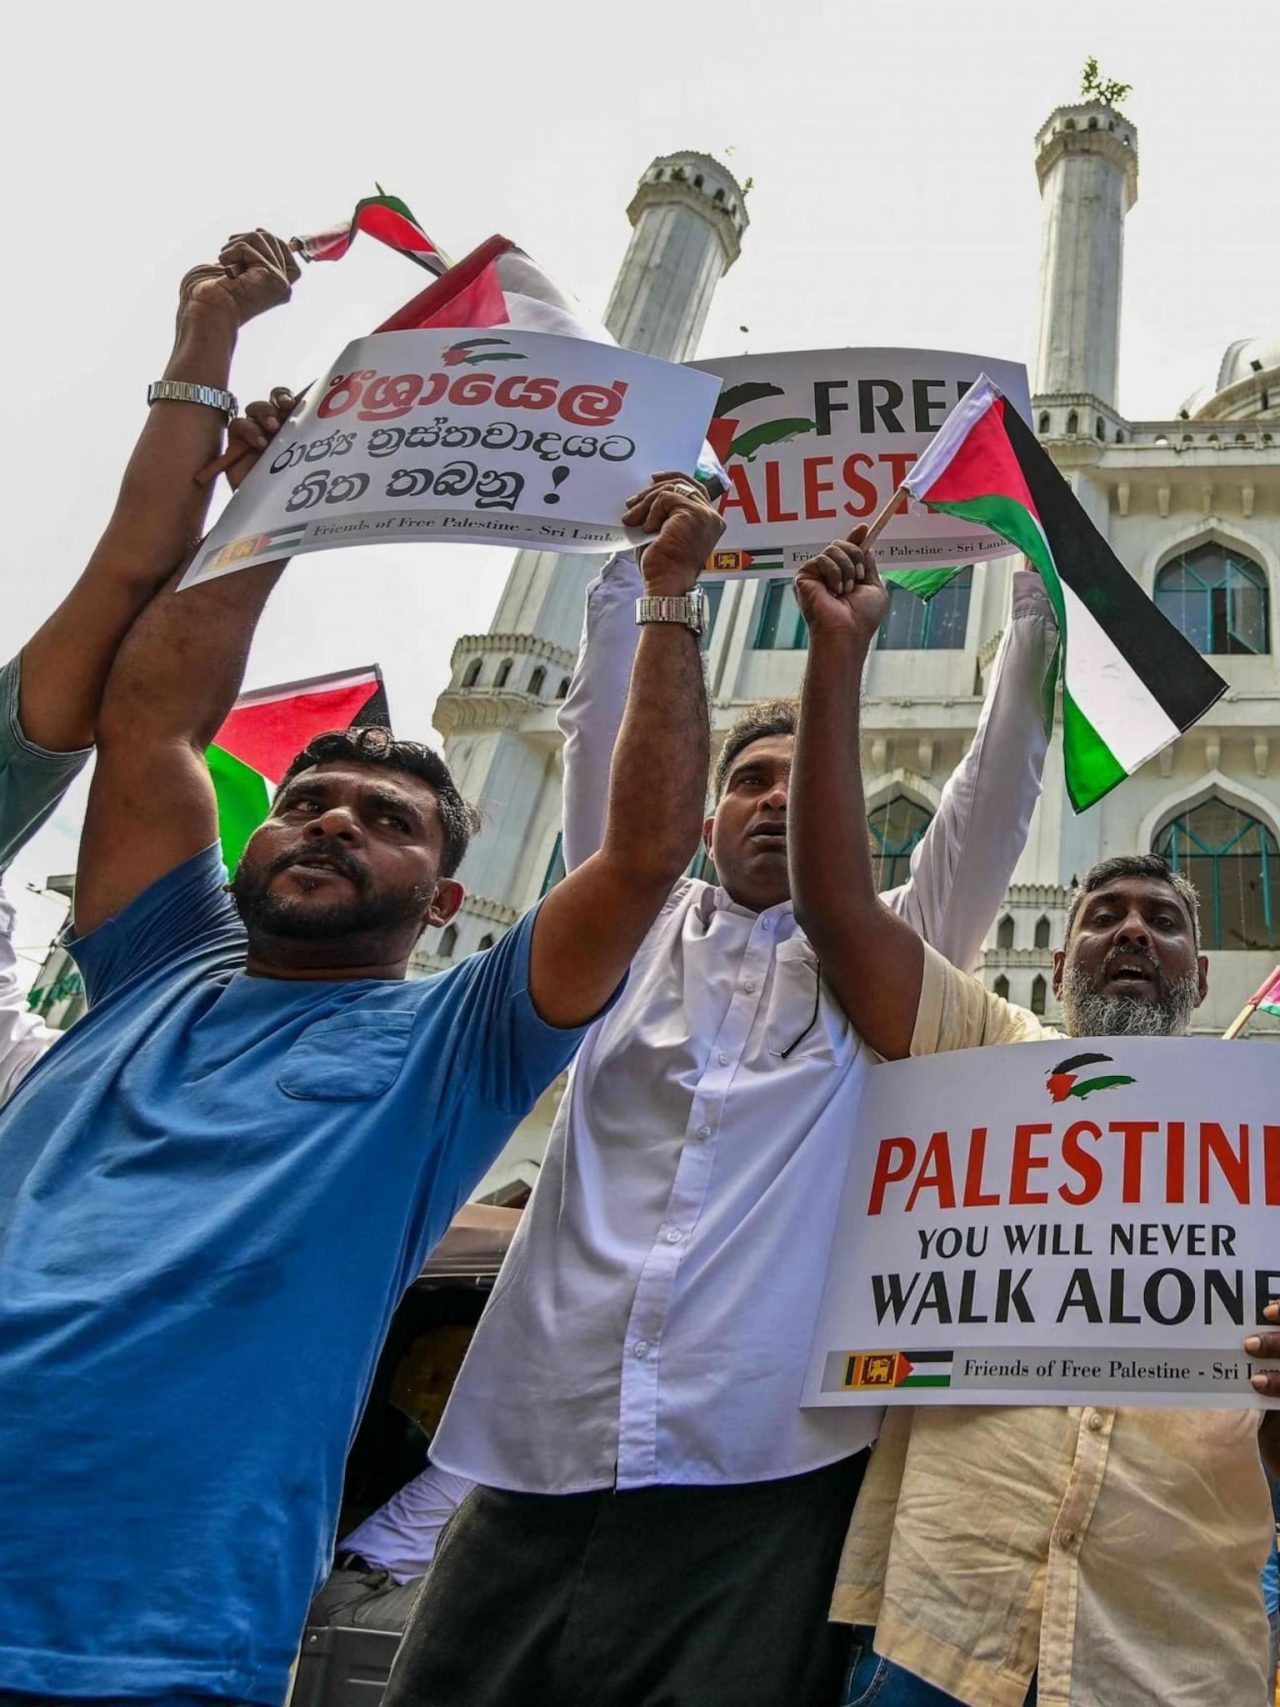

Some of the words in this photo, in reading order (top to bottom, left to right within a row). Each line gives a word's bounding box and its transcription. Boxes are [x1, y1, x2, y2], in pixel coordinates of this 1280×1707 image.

[813, 379, 975, 437] FRE
[543, 466, 570, 505] !
[718, 453, 940, 524] ALEST
[313, 519, 370, 537] Friends
[375, 517, 396, 529] of
[398, 517, 435, 528] Free
[442, 516, 519, 531] Palestine
[539, 525, 566, 537] Sri
[889, 545, 943, 556] Palestine
[956, 543, 974, 553] Sri
[979, 538, 1011, 550] Lank
[918, 1225, 989, 1260] YOU
[1003, 1223, 1093, 1256] WILL
[1110, 1223, 1237, 1257] NEVER
[871, 1268, 1036, 1327] WALK
[963, 1359, 1029, 1377] Friends
[1036, 1359, 1057, 1376] of
[1061, 1359, 1101, 1378] Free
[1109, 1360, 1190, 1379] Palestine
[1212, 1361, 1239, 1379] Sri
